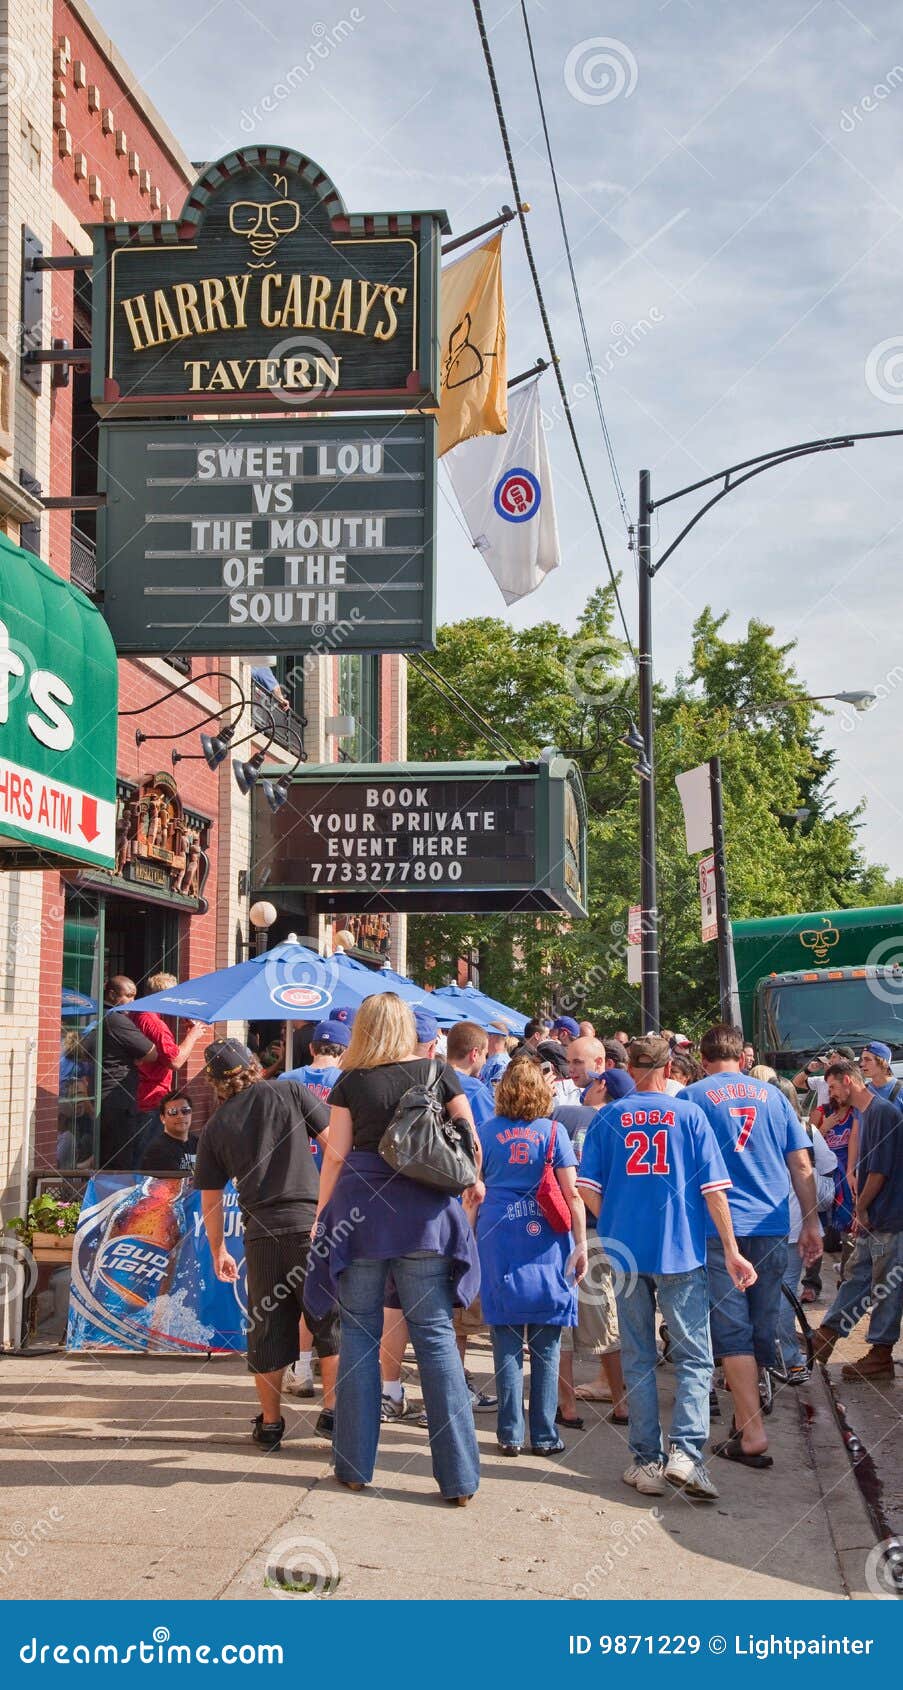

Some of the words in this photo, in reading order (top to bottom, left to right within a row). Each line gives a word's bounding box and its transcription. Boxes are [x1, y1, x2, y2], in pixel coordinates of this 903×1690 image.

[120, 274, 252, 351] HARRY
[260, 273, 408, 341] CARAY'S
[184, 356, 342, 391] TAVERN
[197, 447, 304, 479] SWEET
[319, 444, 384, 476] LOU
[252, 483, 294, 513] VS
[191, 521, 253, 551] THE
[270, 517, 384, 549] MOUTH
[223, 557, 264, 588] OF
[284, 555, 346, 586] THE
[229, 591, 337, 624] SOUTH
[38, 784, 72, 835] ATM
[366, 788, 429, 807] BOOK
[309, 812, 375, 833] YOUR
[391, 811, 496, 832] PRIVATE
[328, 837, 397, 858] EVENT
[412, 836, 468, 857] HERE
[310, 861, 463, 882] 7733277800
[621, 1109, 676, 1127] SOSA
[728, 1106, 757, 1152] 7
[508, 1142, 529, 1165] 16
[624, 1129, 670, 1175] 21
[99, 1255, 168, 1281] LIGHT
[111, 1243, 169, 1268] BUD
